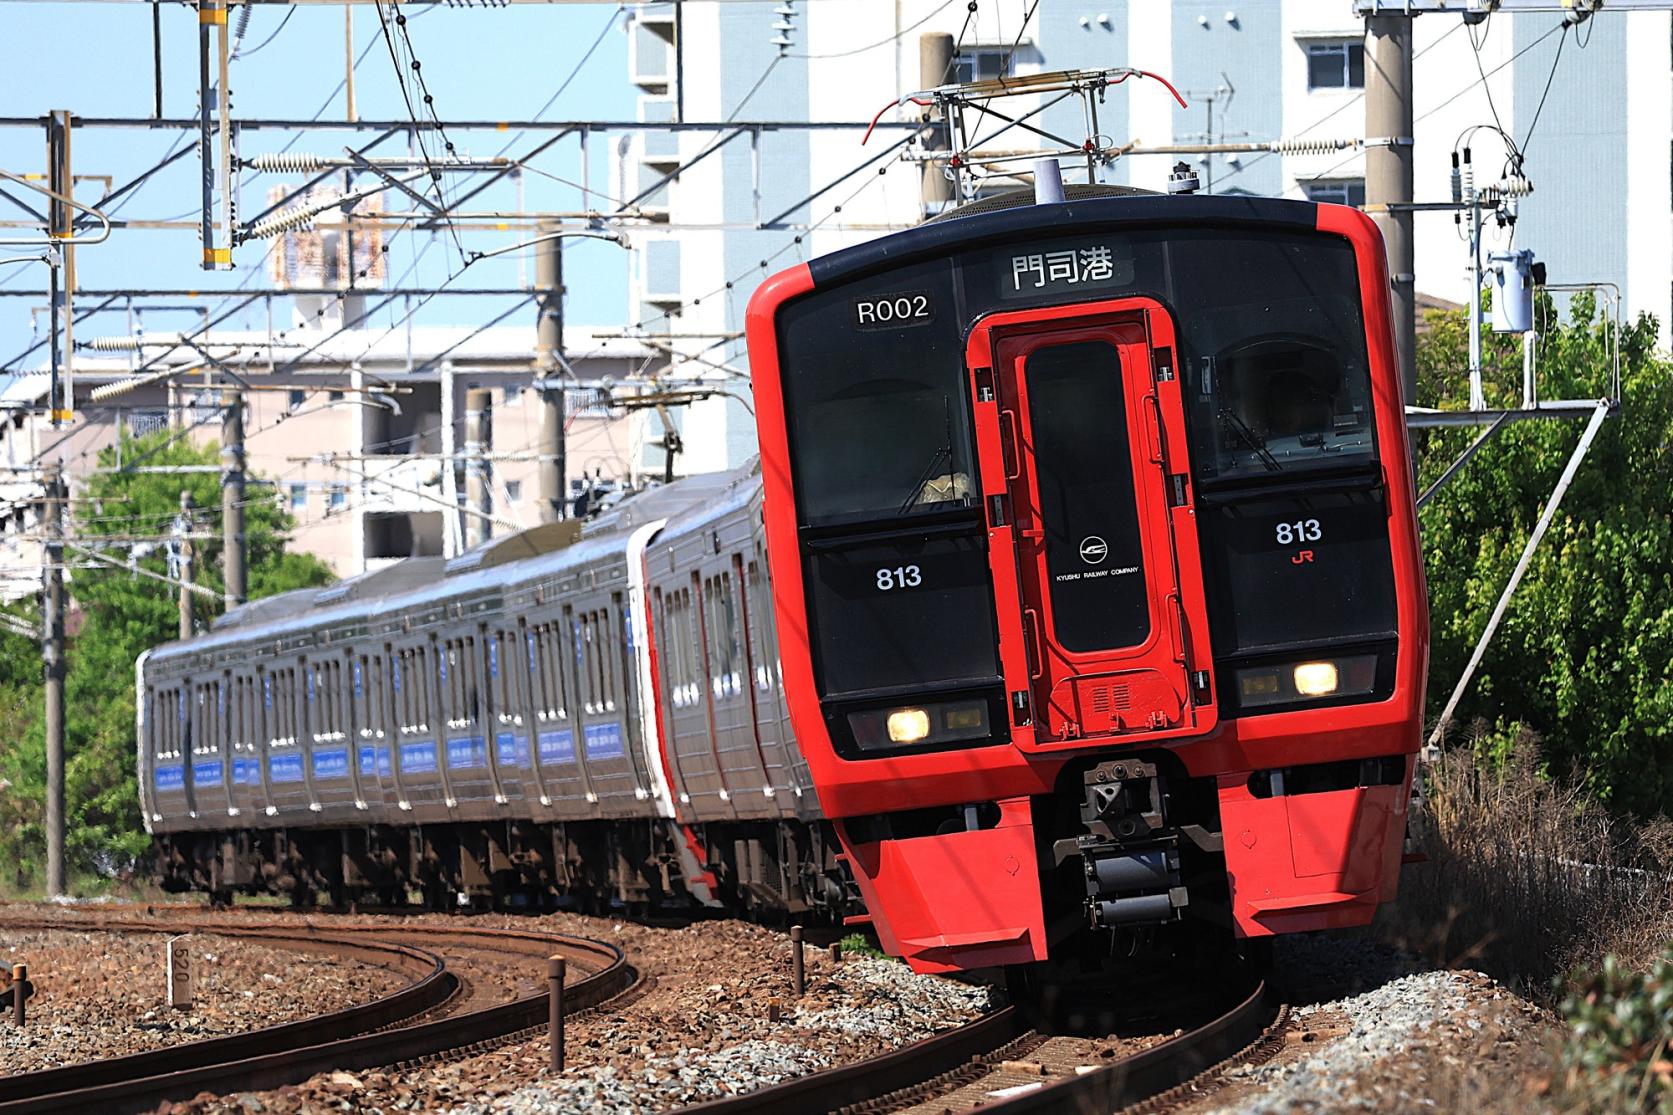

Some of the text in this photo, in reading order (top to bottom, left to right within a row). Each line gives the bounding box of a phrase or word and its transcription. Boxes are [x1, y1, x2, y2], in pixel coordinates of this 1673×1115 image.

[1011, 246, 1113, 290] 門司港
[857, 296, 929, 324] R002
[1276, 519, 1322, 544] 813
[1291, 550, 1313, 564] JR
[876, 565, 922, 590] 813
[1056, 566, 1139, 581] KYUSHU RAILWAY COMPANY
[174, 948, 190, 982] 520
